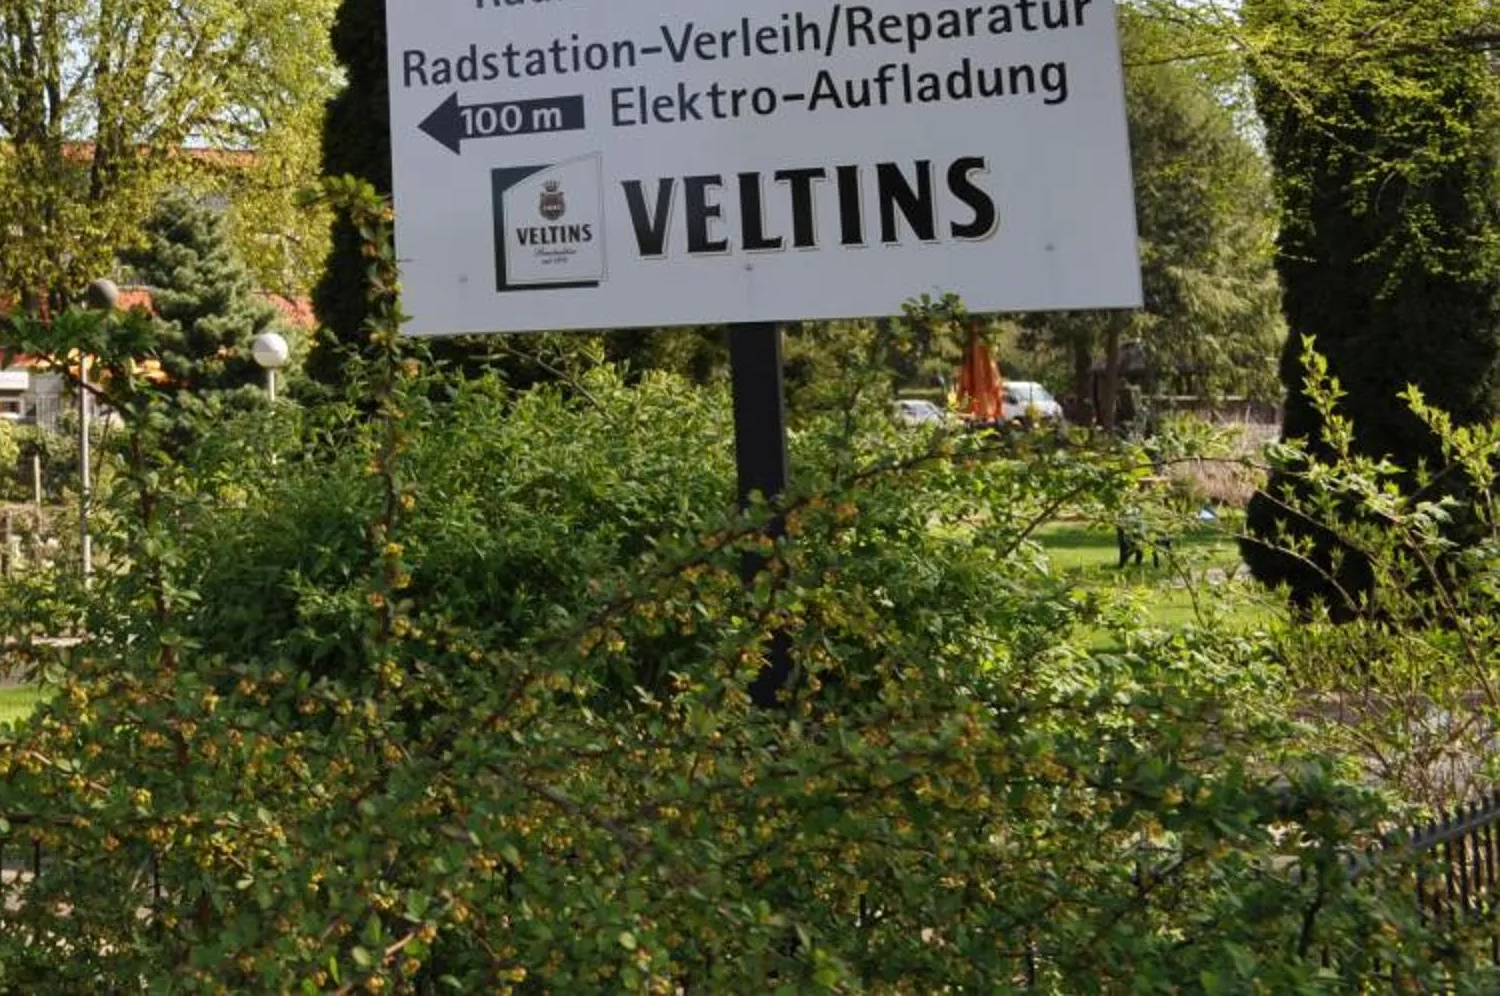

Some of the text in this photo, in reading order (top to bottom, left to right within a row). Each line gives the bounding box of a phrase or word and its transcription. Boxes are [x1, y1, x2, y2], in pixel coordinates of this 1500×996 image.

[611, 57, 1068, 128] Elektro-Aufladung
[460, 105, 563, 136] 100 m
[621, 156, 998, 258] VELTINS
[516, 224, 593, 246] VELTINS
